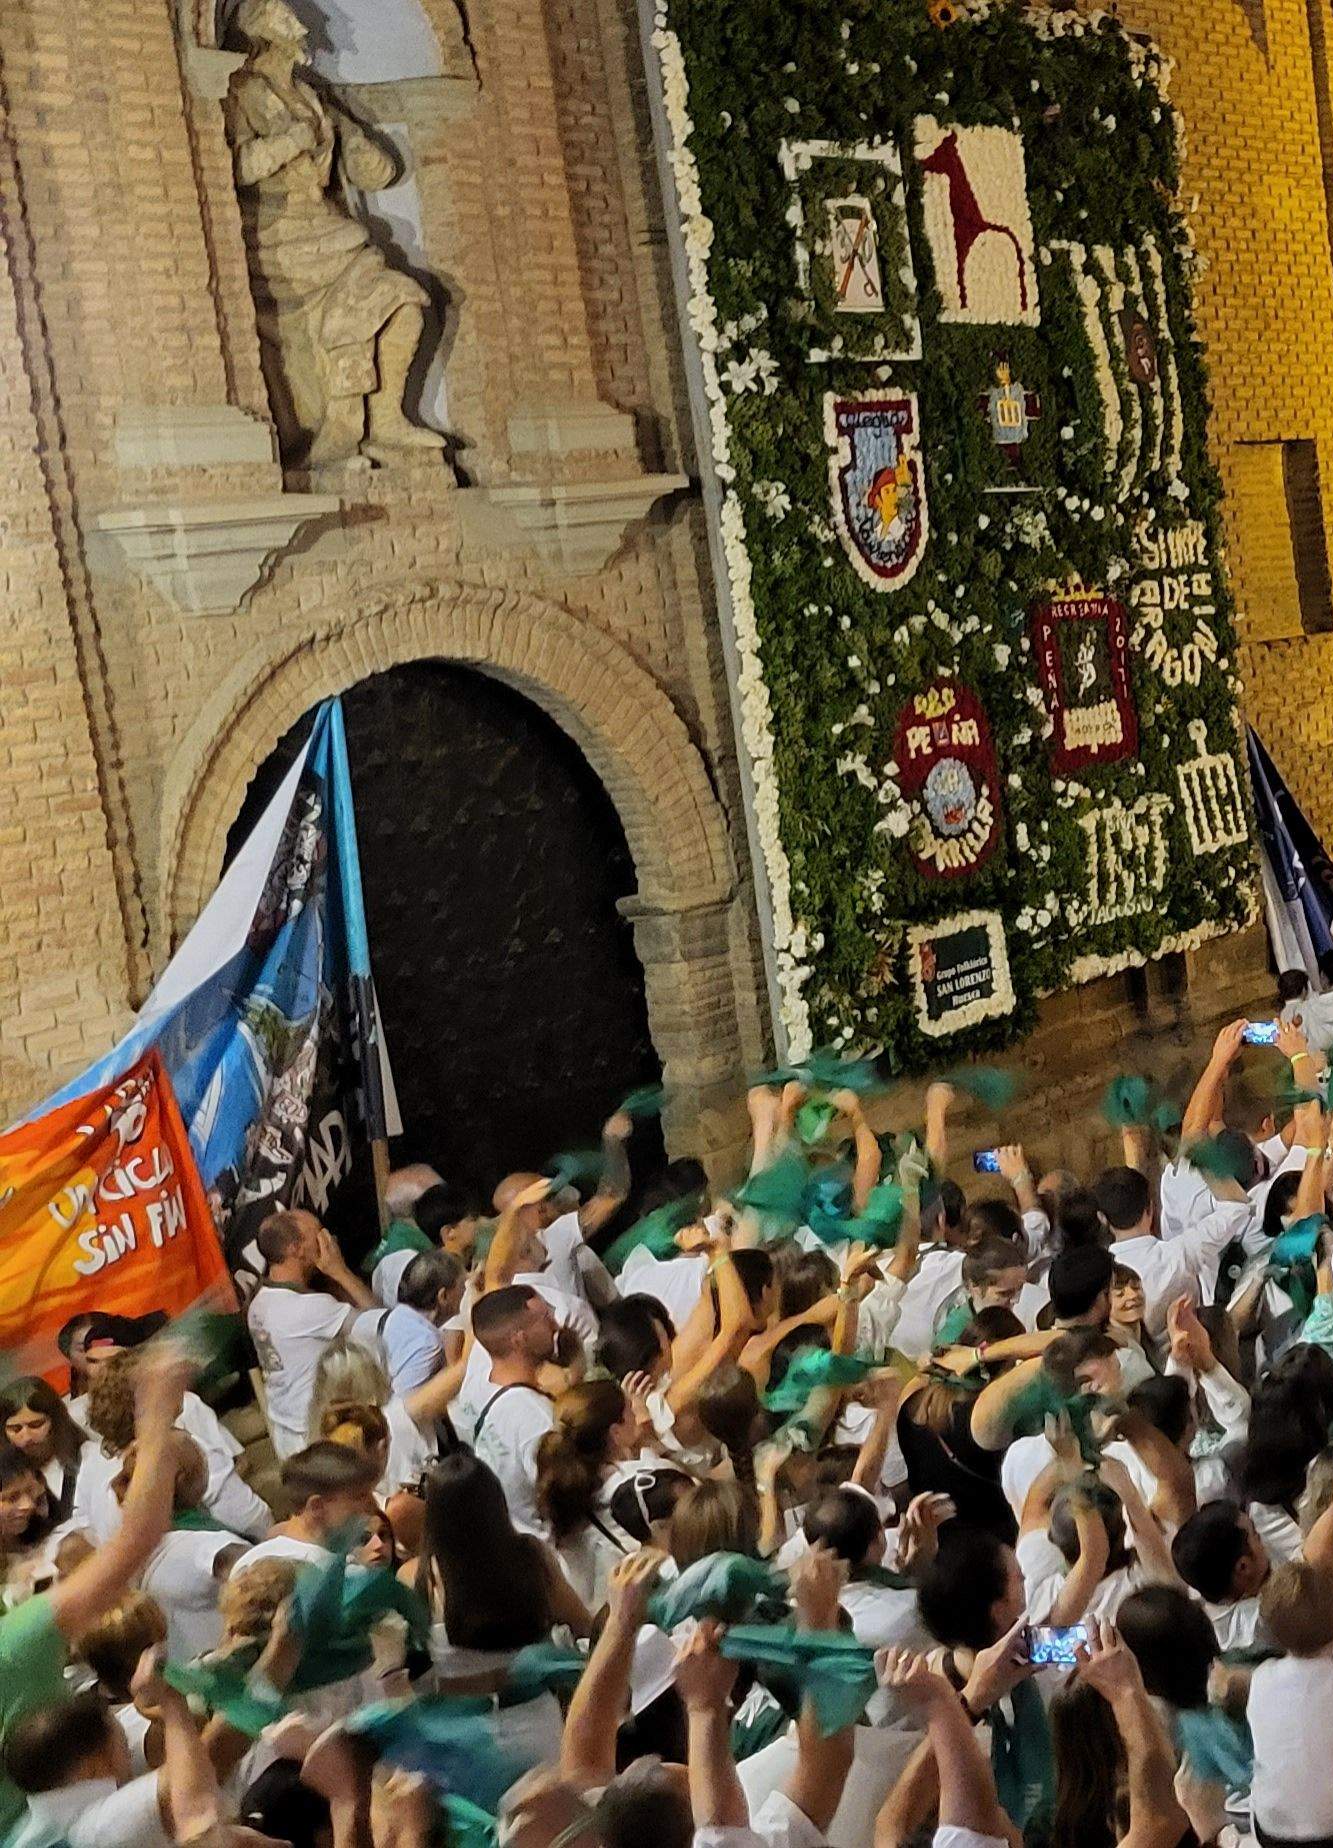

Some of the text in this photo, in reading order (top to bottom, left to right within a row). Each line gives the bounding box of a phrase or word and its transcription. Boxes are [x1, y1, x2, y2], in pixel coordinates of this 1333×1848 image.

[1163, 574, 1190, 610] DE
[1042, 625, 1060, 710] PEÑA
[937, 967, 956, 981] Grupo
[937, 968, 991, 997] SAN LORENZO
